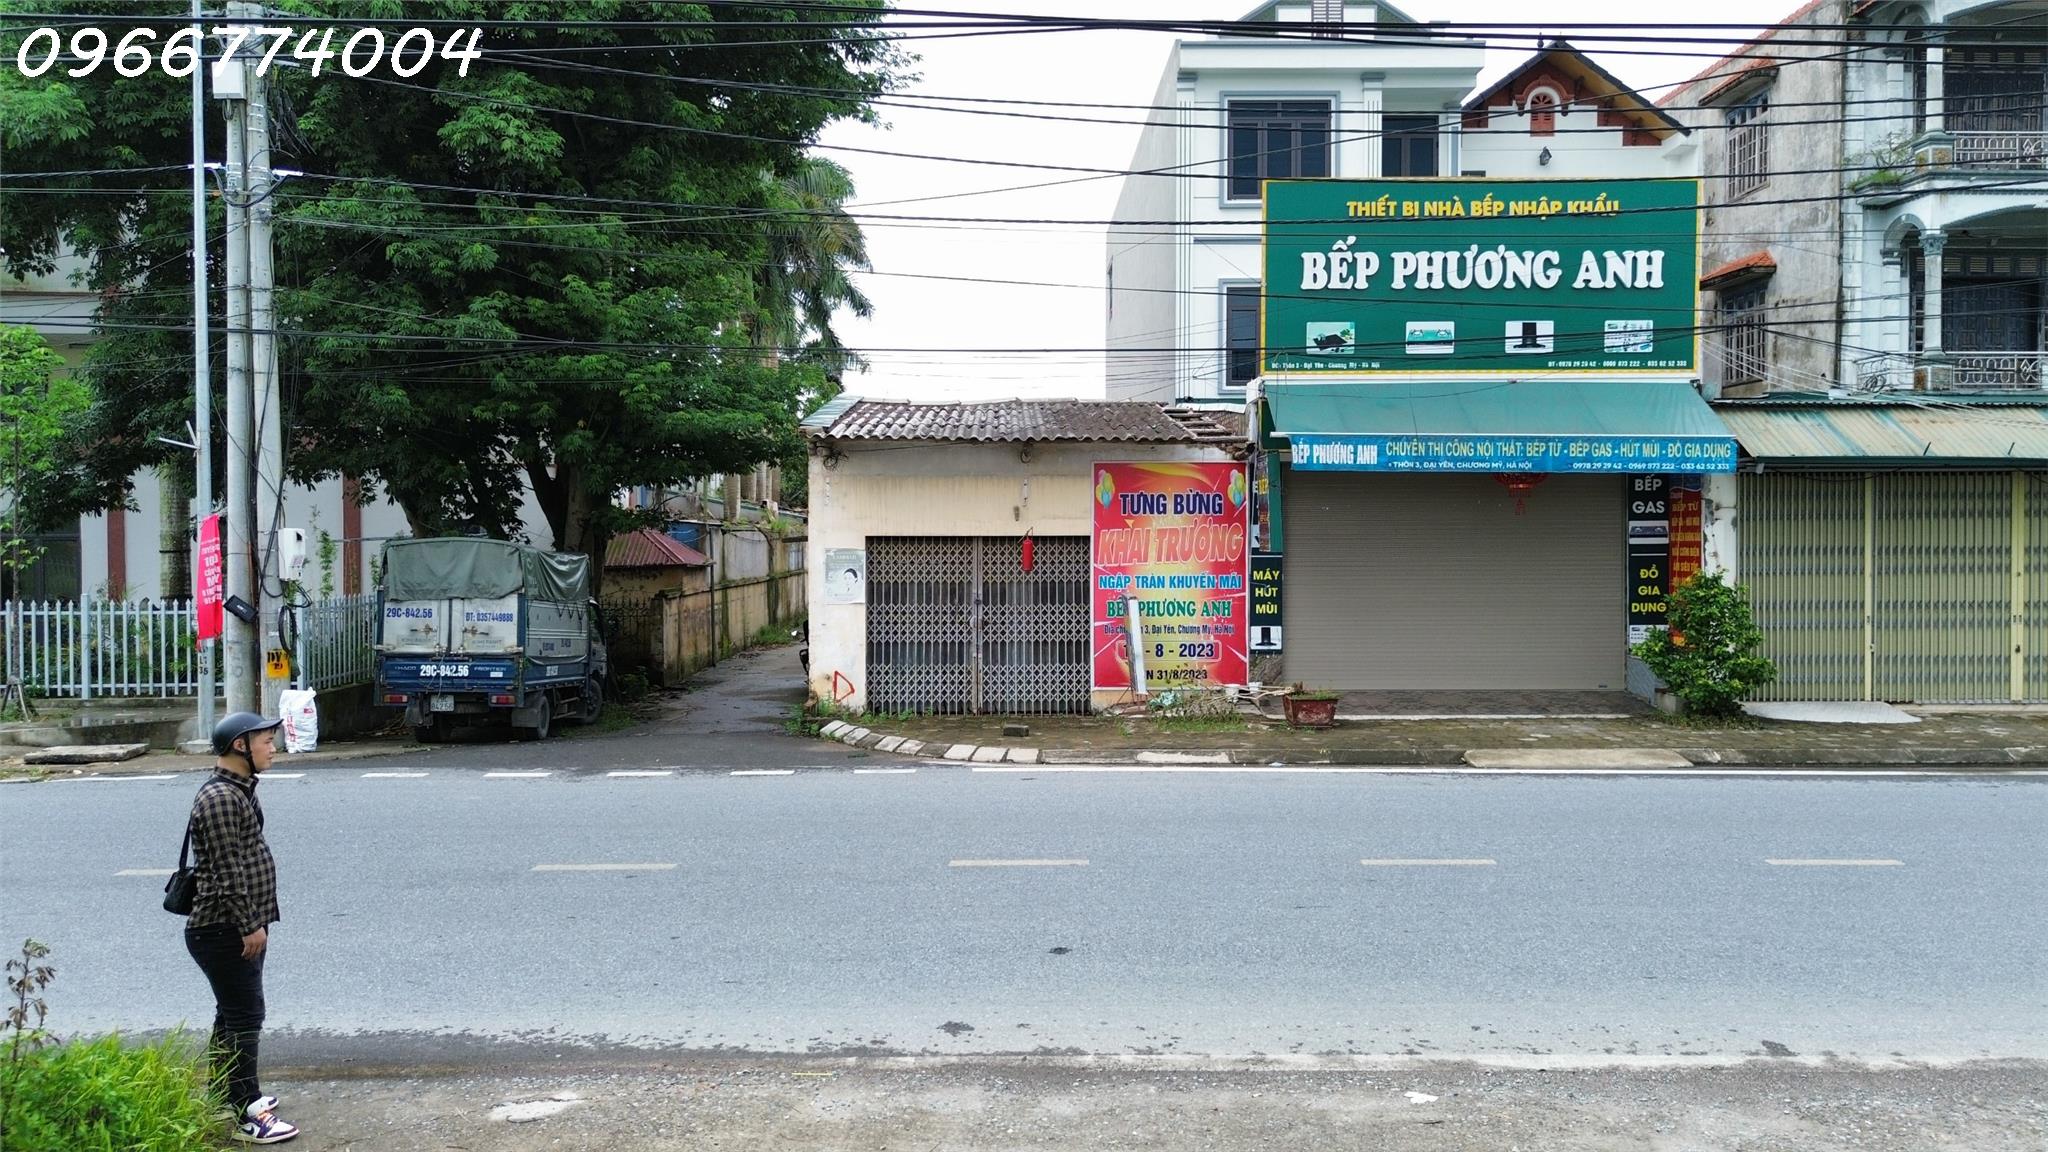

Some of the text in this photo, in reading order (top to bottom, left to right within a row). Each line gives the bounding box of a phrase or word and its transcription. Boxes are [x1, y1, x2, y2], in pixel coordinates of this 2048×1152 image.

[1347, 192, 1619, 220] THIẾT BỊ NHÀ BẾP NHẬP KHẨU
[1301, 235, 1666, 290] BẾP PHƯƠNG ANH
[1291, 438, 1378, 465] BẾP PHƯƠNG ANH
[1385, 439, 1425, 457] CHUYÊN
[1427, 442, 1443, 457] THI
[1445, 440, 1474, 457] CÔNG
[1476, 440, 1494, 459] NỘI
[1526, 438, 1546, 457] BẾP
[1569, 440, 1590, 457] BẾP
[1591, 443, 1612, 457] GAS
[1620, 440, 1641, 457] HÚT
[1642, 440, 1660, 457] MÙI
[1667, 441, 1682, 457] ĐỒ
[1684, 443, 1701, 457] GIA
[1703, 443, 1731, 461] DỤNG
[1456, 460, 1490, 468] CHƯƠNG
[1634, 474, 1663, 491] BẾP
[1119, 488, 1224, 516] TƯNG BỪNG
[1632, 501, 1665, 514] GAS
[1154, 517, 1244, 565] TRƯƠNG
[1099, 572, 1131, 592] NGẬP
[1169, 570, 1217, 589] KHUYẾN
[1219, 571, 1243, 589] MÃI
[1253, 568, 1280, 581] MÁY
[1255, 585, 1278, 597] HÚT
[1637, 585, 1661, 596] GIA
[386, 608, 433, 618] 29C-842.56
[1139, 598, 1197, 617] PHƯƠNG
[1201, 599, 1233, 617] ANH
[1256, 601, 1278, 614] MÙI
[1631, 602, 1667, 616] DỤNG
[1152, 624, 1162, 636] Đại
[1178, 623, 1201, 636] Chương
[1214, 623, 1223, 635] Hà
[1155, 643, 1164, 658] 8
[1178, 643, 1215, 658] 2023
[419, 664, 469, 677] 29C-842.56
[1156, 669, 1208, 680] 31/8/2023
